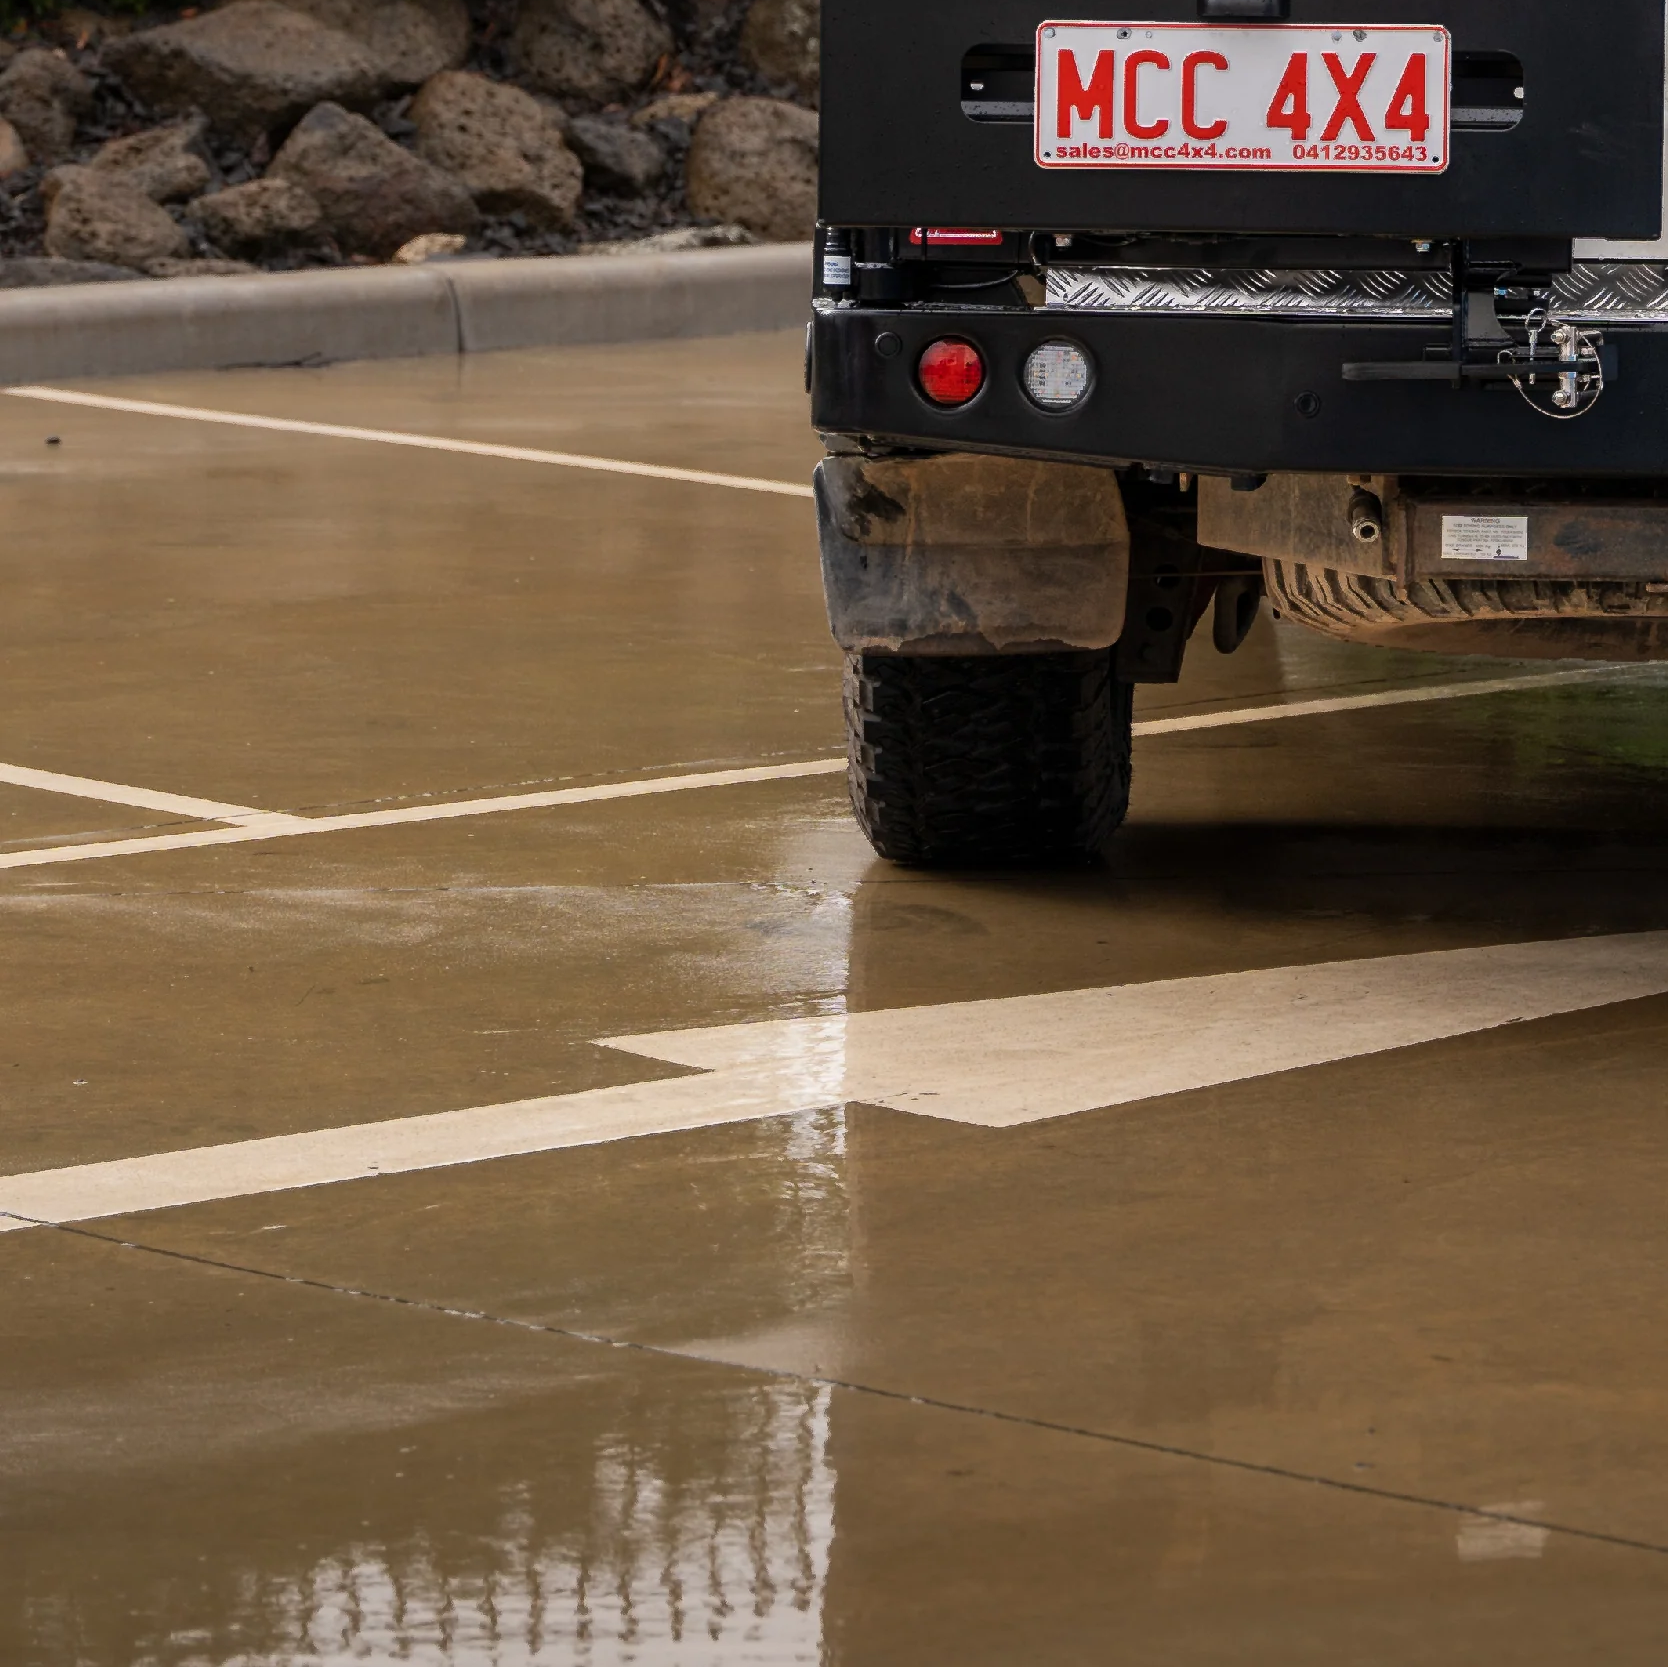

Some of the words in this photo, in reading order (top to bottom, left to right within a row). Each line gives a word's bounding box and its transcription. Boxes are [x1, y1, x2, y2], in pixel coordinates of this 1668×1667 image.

[1056, 47, 1230, 141] MCC
[1266, 51, 1431, 143] 4X4
[1055, 142, 1273, 162] sales@mcc4x4.com
[1292, 144, 1429, 163] 0412935643
